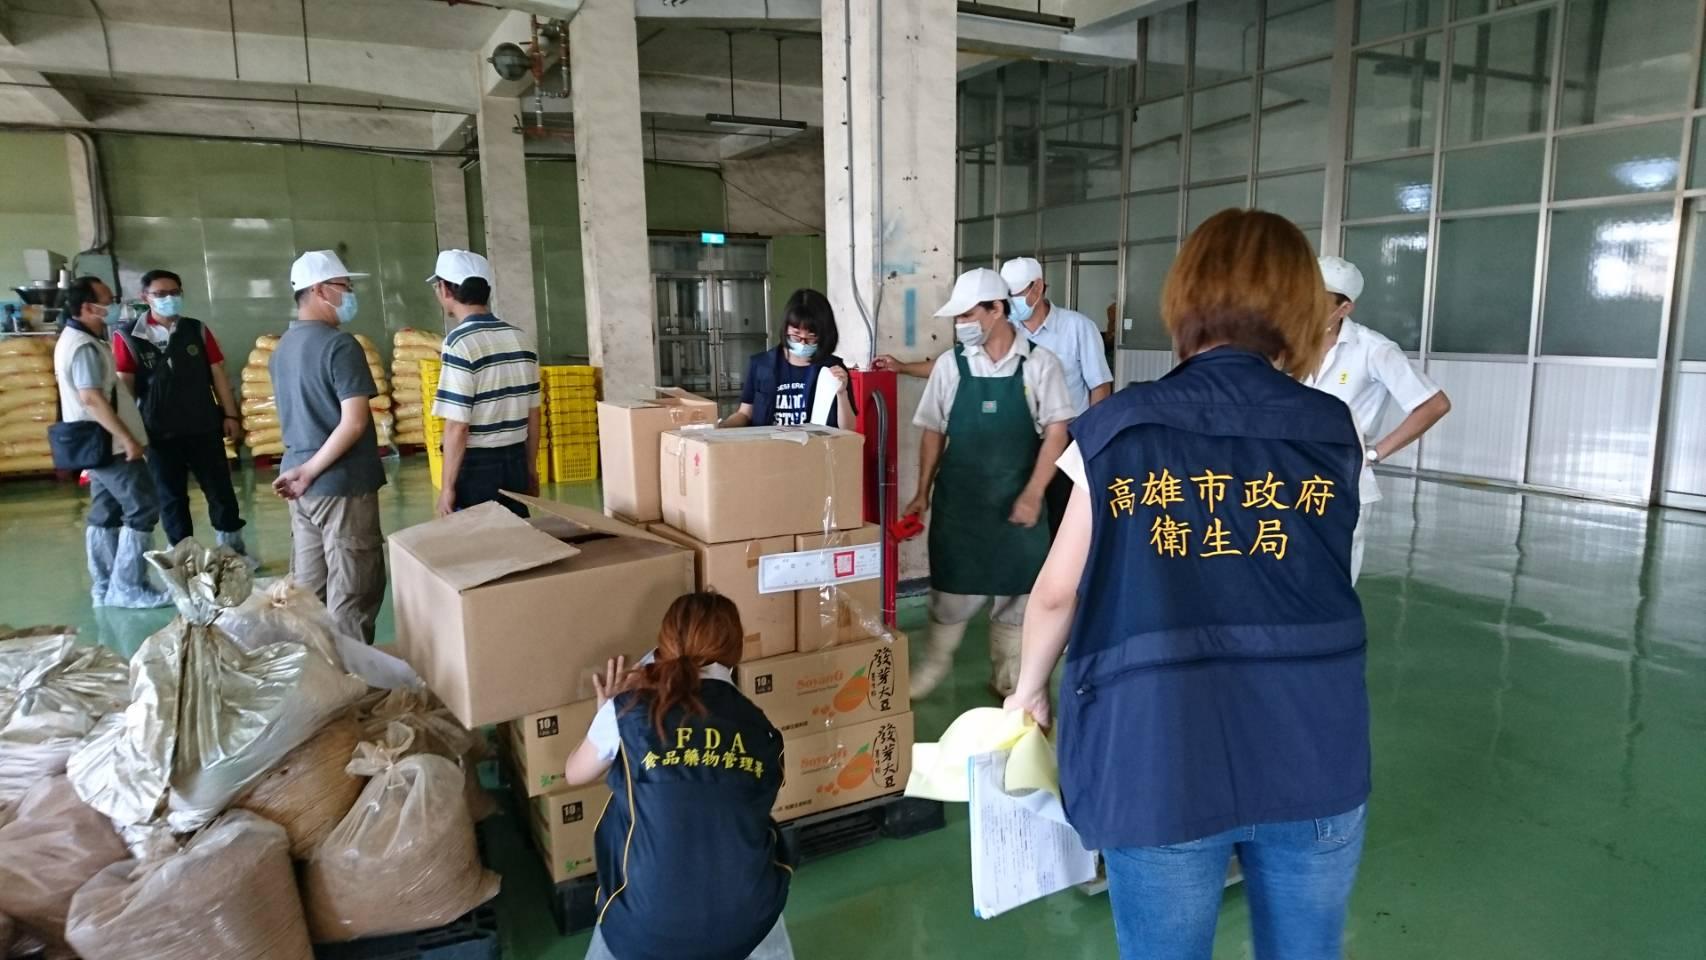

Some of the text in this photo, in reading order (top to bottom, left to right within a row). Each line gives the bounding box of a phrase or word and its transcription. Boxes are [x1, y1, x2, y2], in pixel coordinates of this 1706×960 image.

[1107, 468, 1336, 518] 高雄市政府
[1150, 514, 1289, 560] 衛生局
[874, 646, 892, 711] 發芽大豆
[641, 746, 764, 779] 食品藥物管理署
[878, 722, 896, 788] 發芽大豆
